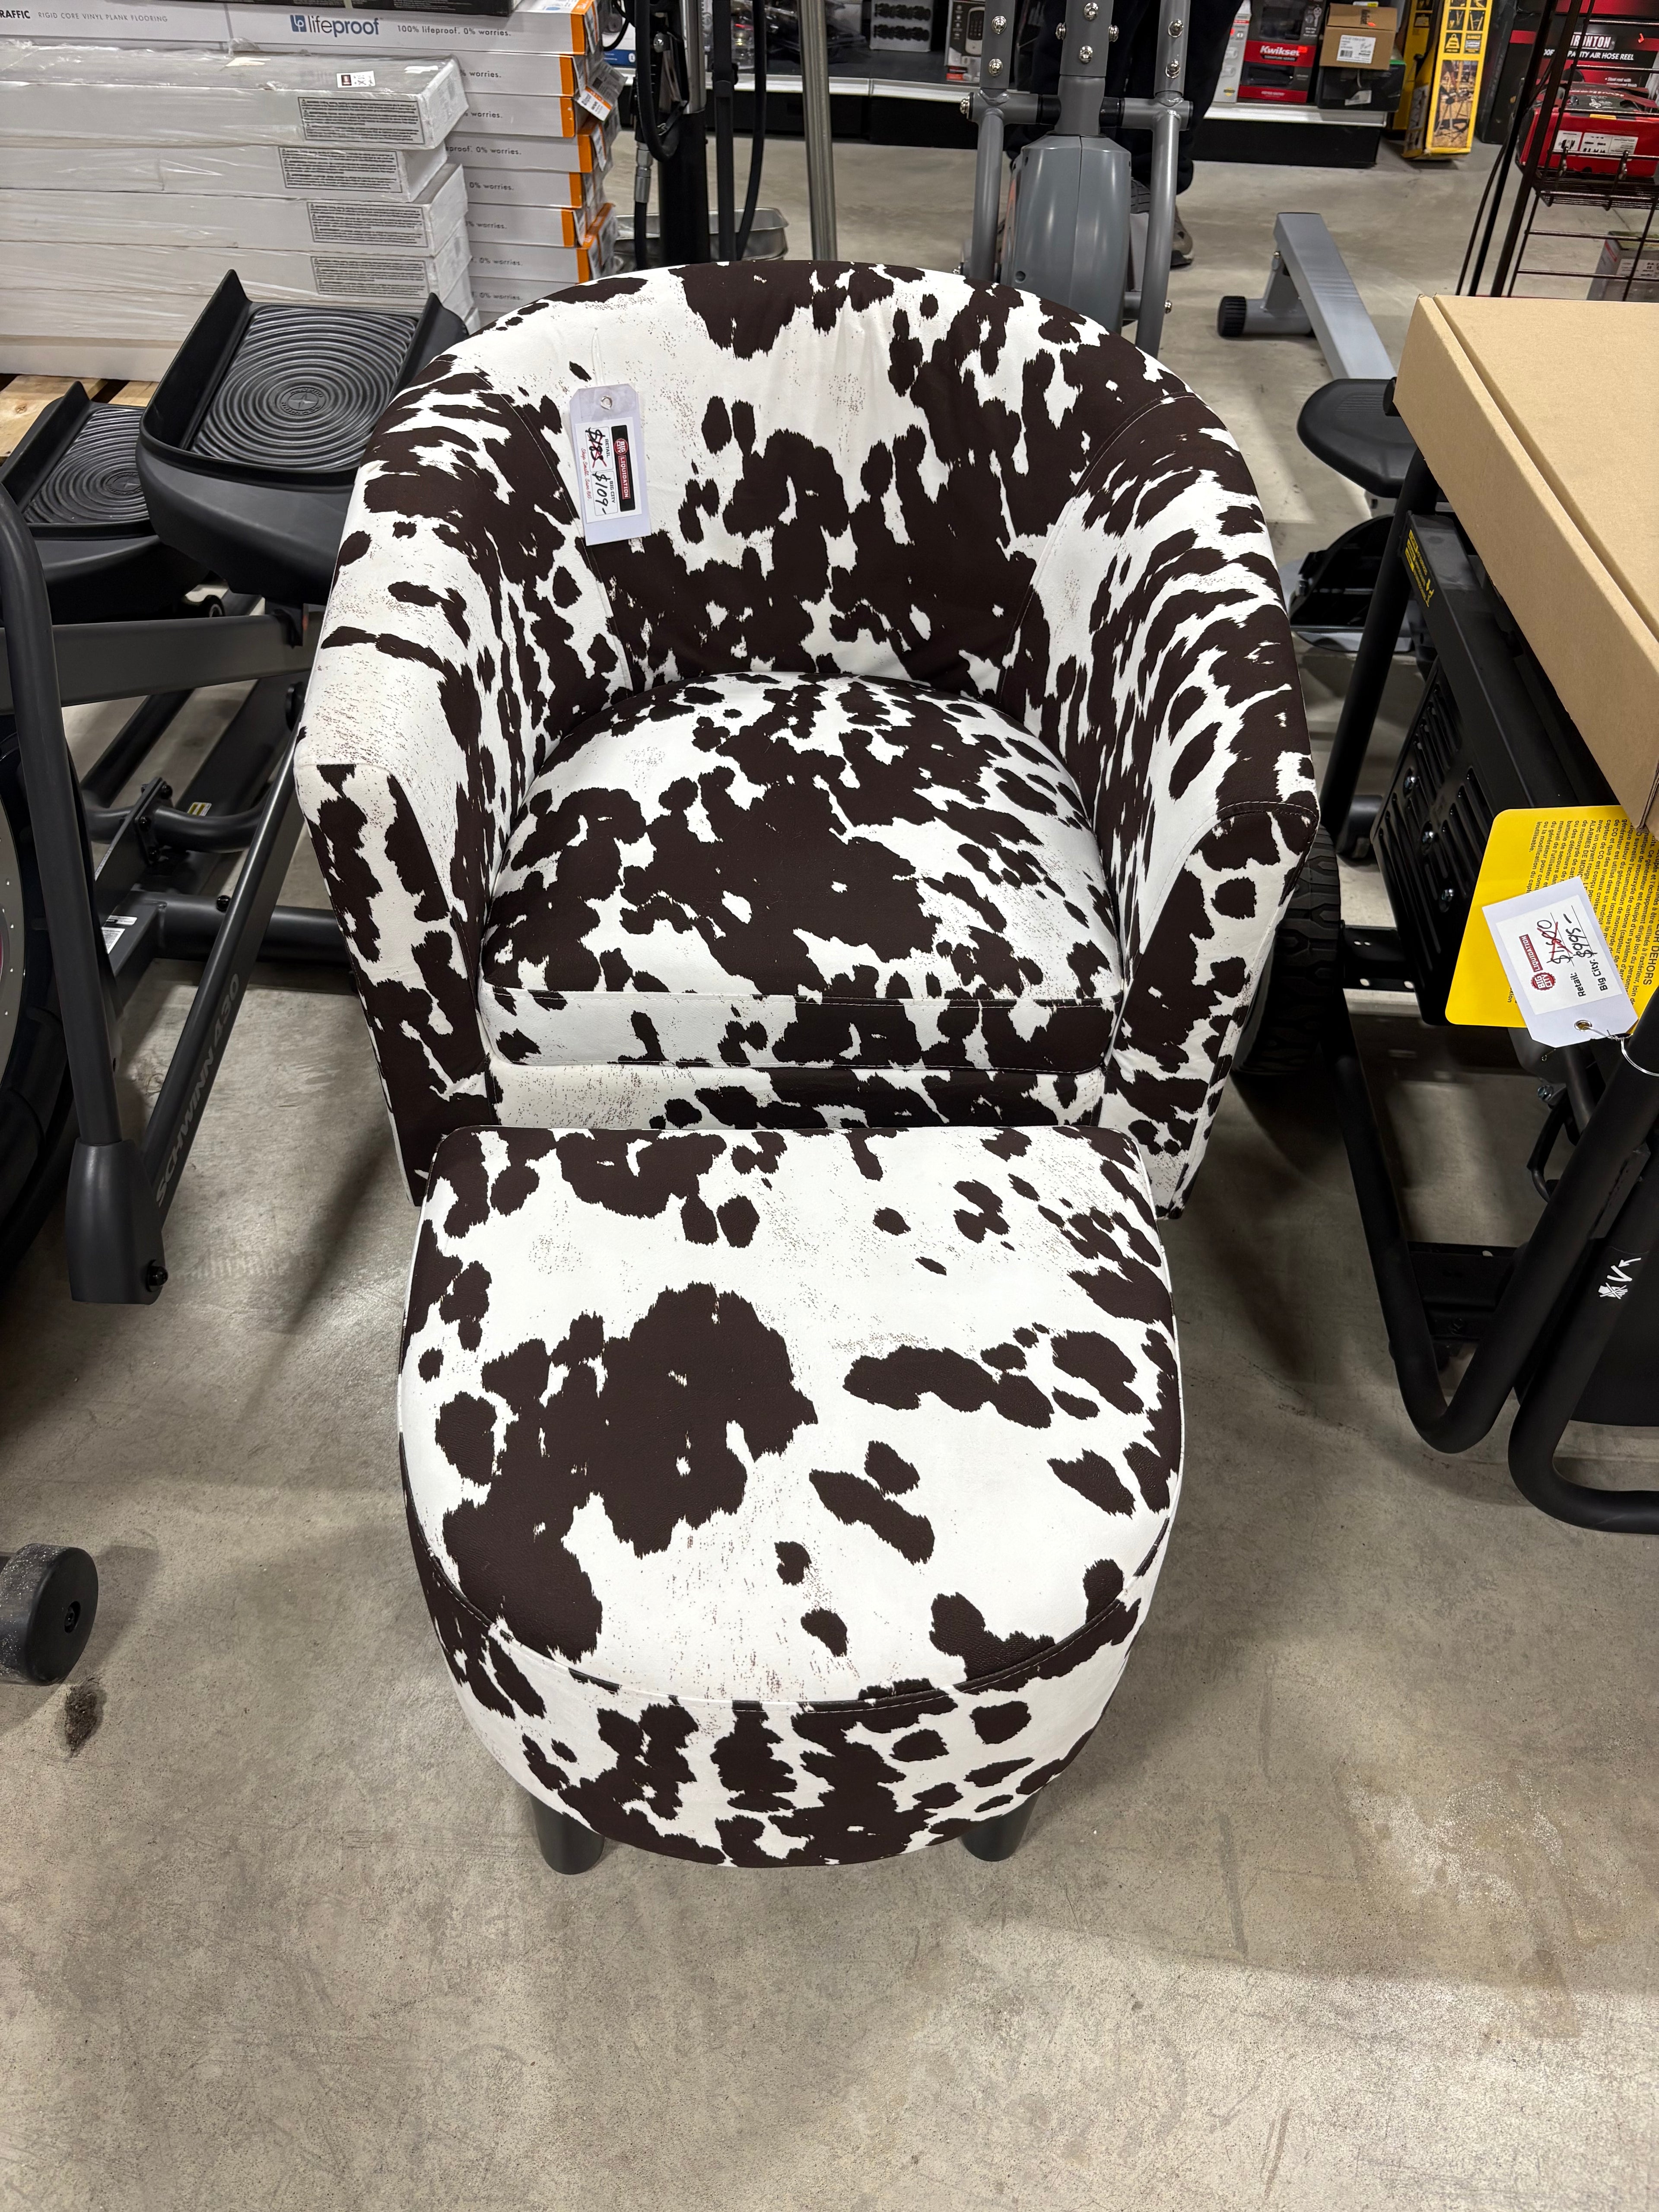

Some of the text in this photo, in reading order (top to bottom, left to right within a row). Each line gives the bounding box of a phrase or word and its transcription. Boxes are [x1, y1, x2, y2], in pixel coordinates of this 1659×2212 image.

[397, 25, 420, 33] 100%
[478, 29, 512, 37] worries.
[620, 456, 629, 498] LIQUIDATION
[1529, 822, 1541, 852] inutilisable.
[1555, 821, 1564, 840] manuel
[1563, 821, 1573, 841] batterie
[1585, 820, 1596, 848] ALARMES
[1602, 820, 1611, 840] capteur
[1611, 828, 1618, 836] CO
[1532, 836, 1545, 869] modification
[1574, 828, 1585, 857] monoxyde
[1589, 843, 1597, 861] voyant
[1622, 842, 1630, 860] autour
[1630, 838, 1640, 862] surveille
[1545, 850, 1557, 880] l'utilisateur
[1555, 851, 1564, 873] secours
[1598, 851, 1604, 859] CO
[1598, 869, 1607, 890] niveaux
[1619, 864, 1634, 905] l'accumulation
[1630, 864, 1641, 894] monoxyde
[1606, 903, 1616, 924] lorsque
[1622, 905, 1631, 928] carbone
[1609, 915, 1621, 946] monoxyde
[1616, 930, 1626, 953] (capteur
[1521, 935, 1542, 970] LIQUIDATION
[1589, 959, 1603, 976] City:
[1643, 946, 1659, 985] DEHORS
[1570, 972, 1586, 997] Retail:
[1595, 977, 1608, 992] Big
[156, 973, 239, 1207] SCHWINN 430
